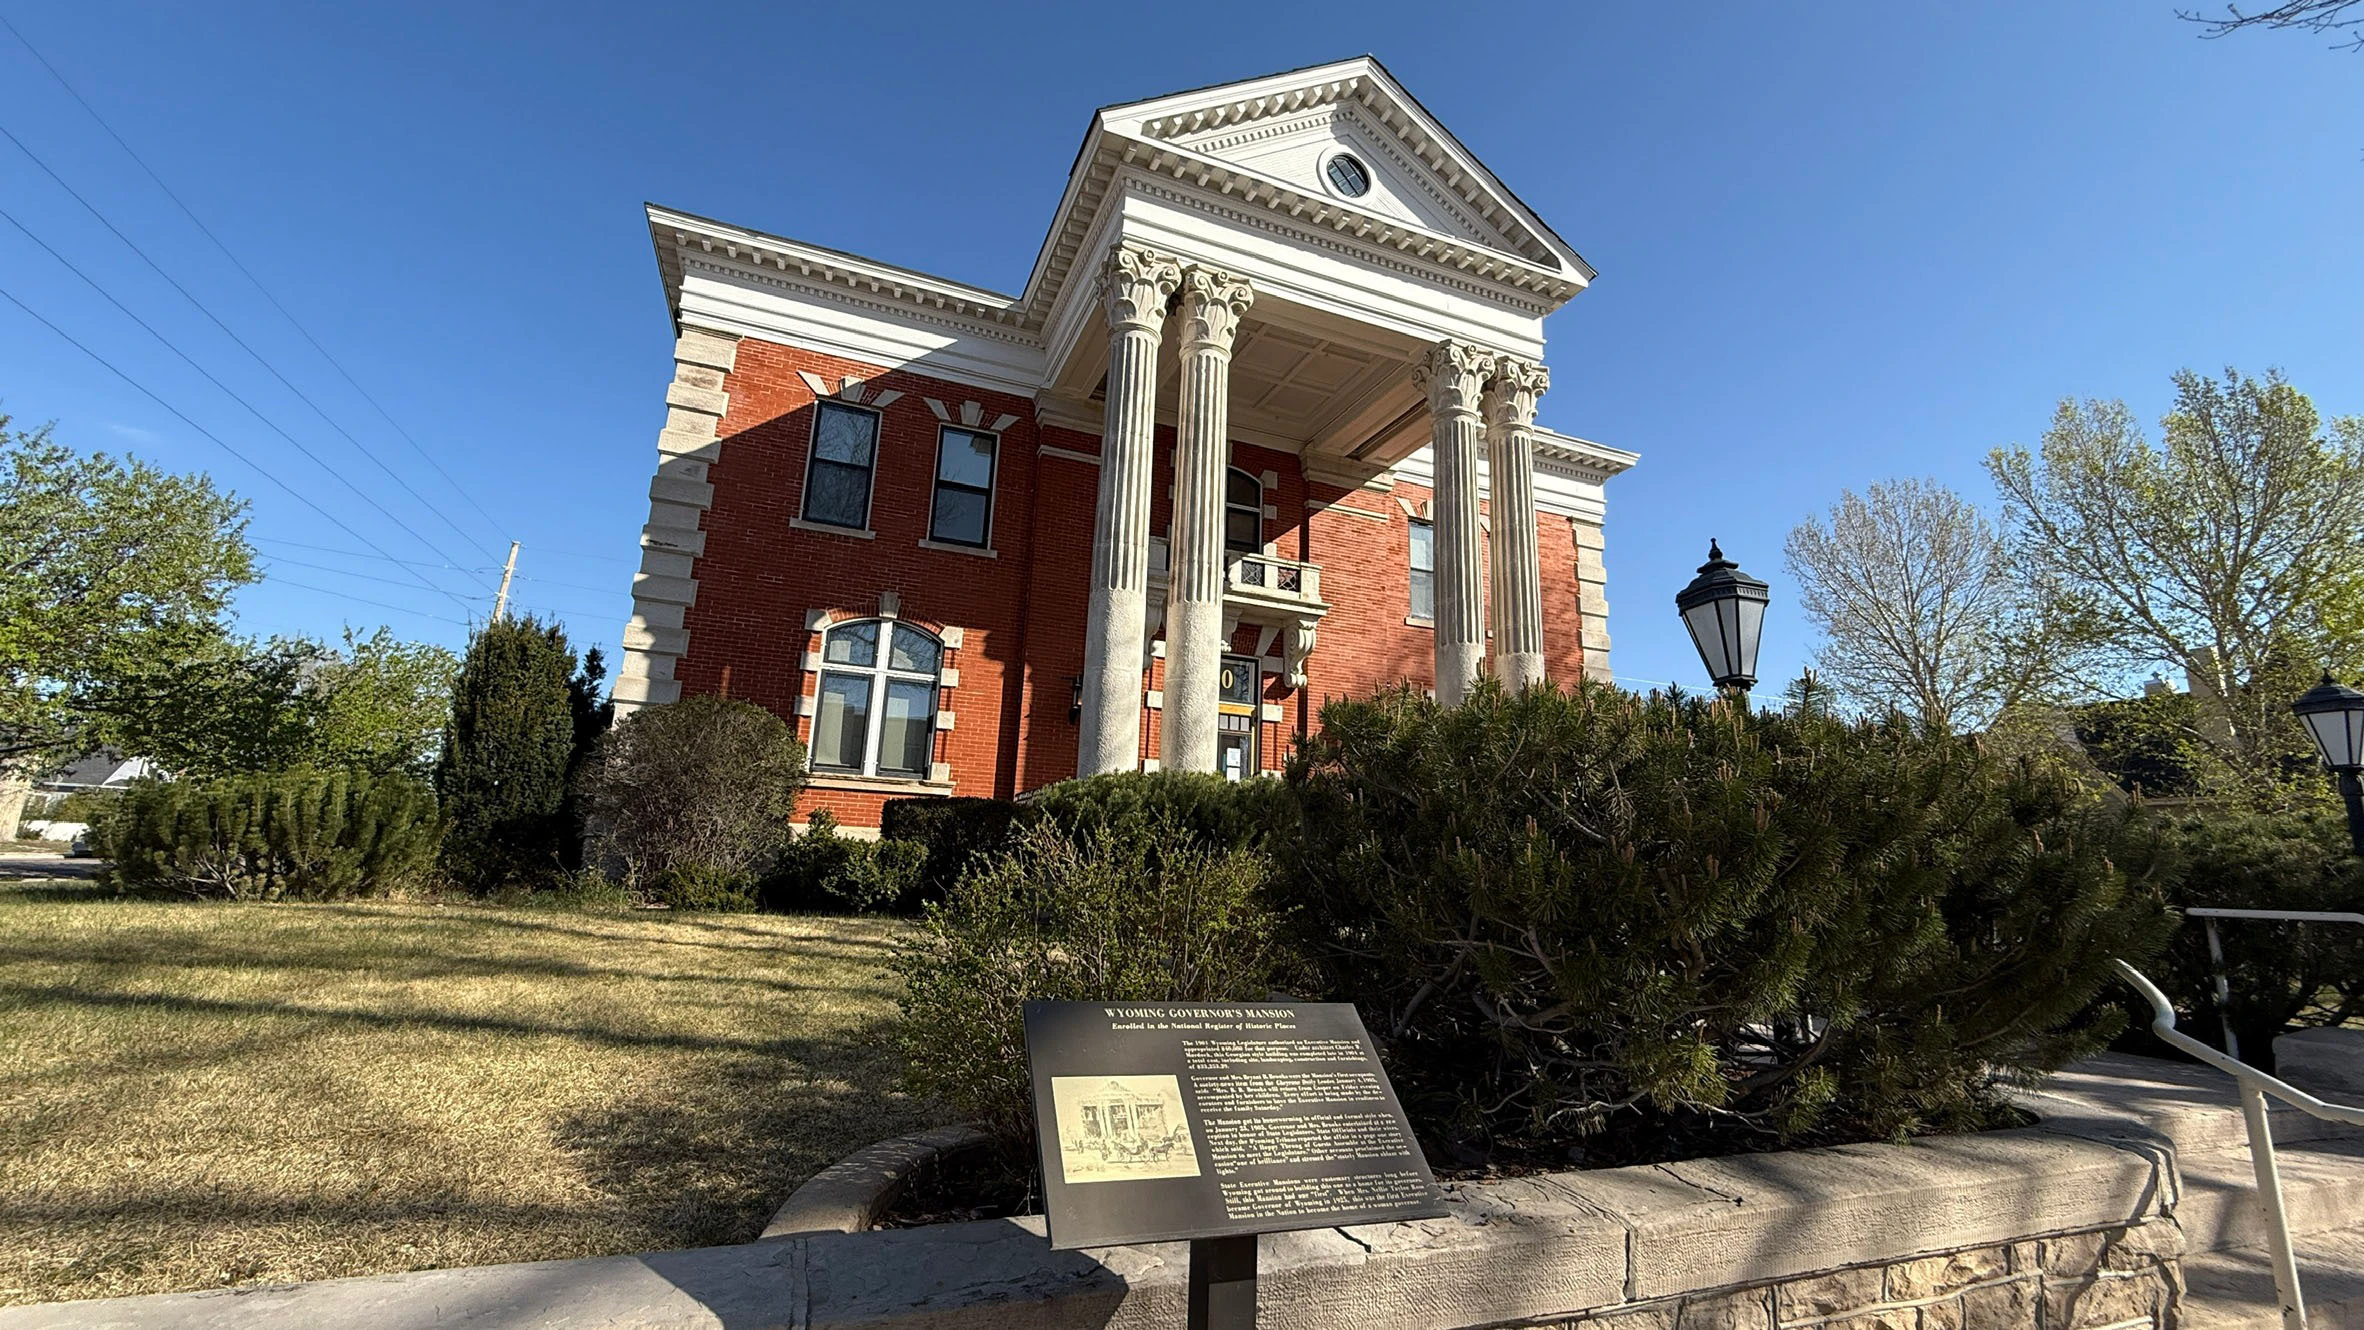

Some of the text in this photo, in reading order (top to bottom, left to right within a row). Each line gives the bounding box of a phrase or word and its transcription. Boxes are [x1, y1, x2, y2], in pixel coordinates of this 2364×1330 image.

[1104, 1008, 1295, 1018] WYOMING GOVERNOR'S MANSION
[1204, 1022, 1233, 1030] Register
[1236, 1022, 1243, 1030] of
[1222, 1189, 1252, 1197] Wyoming
[1294, 1199, 1323, 1208] Wyoming
